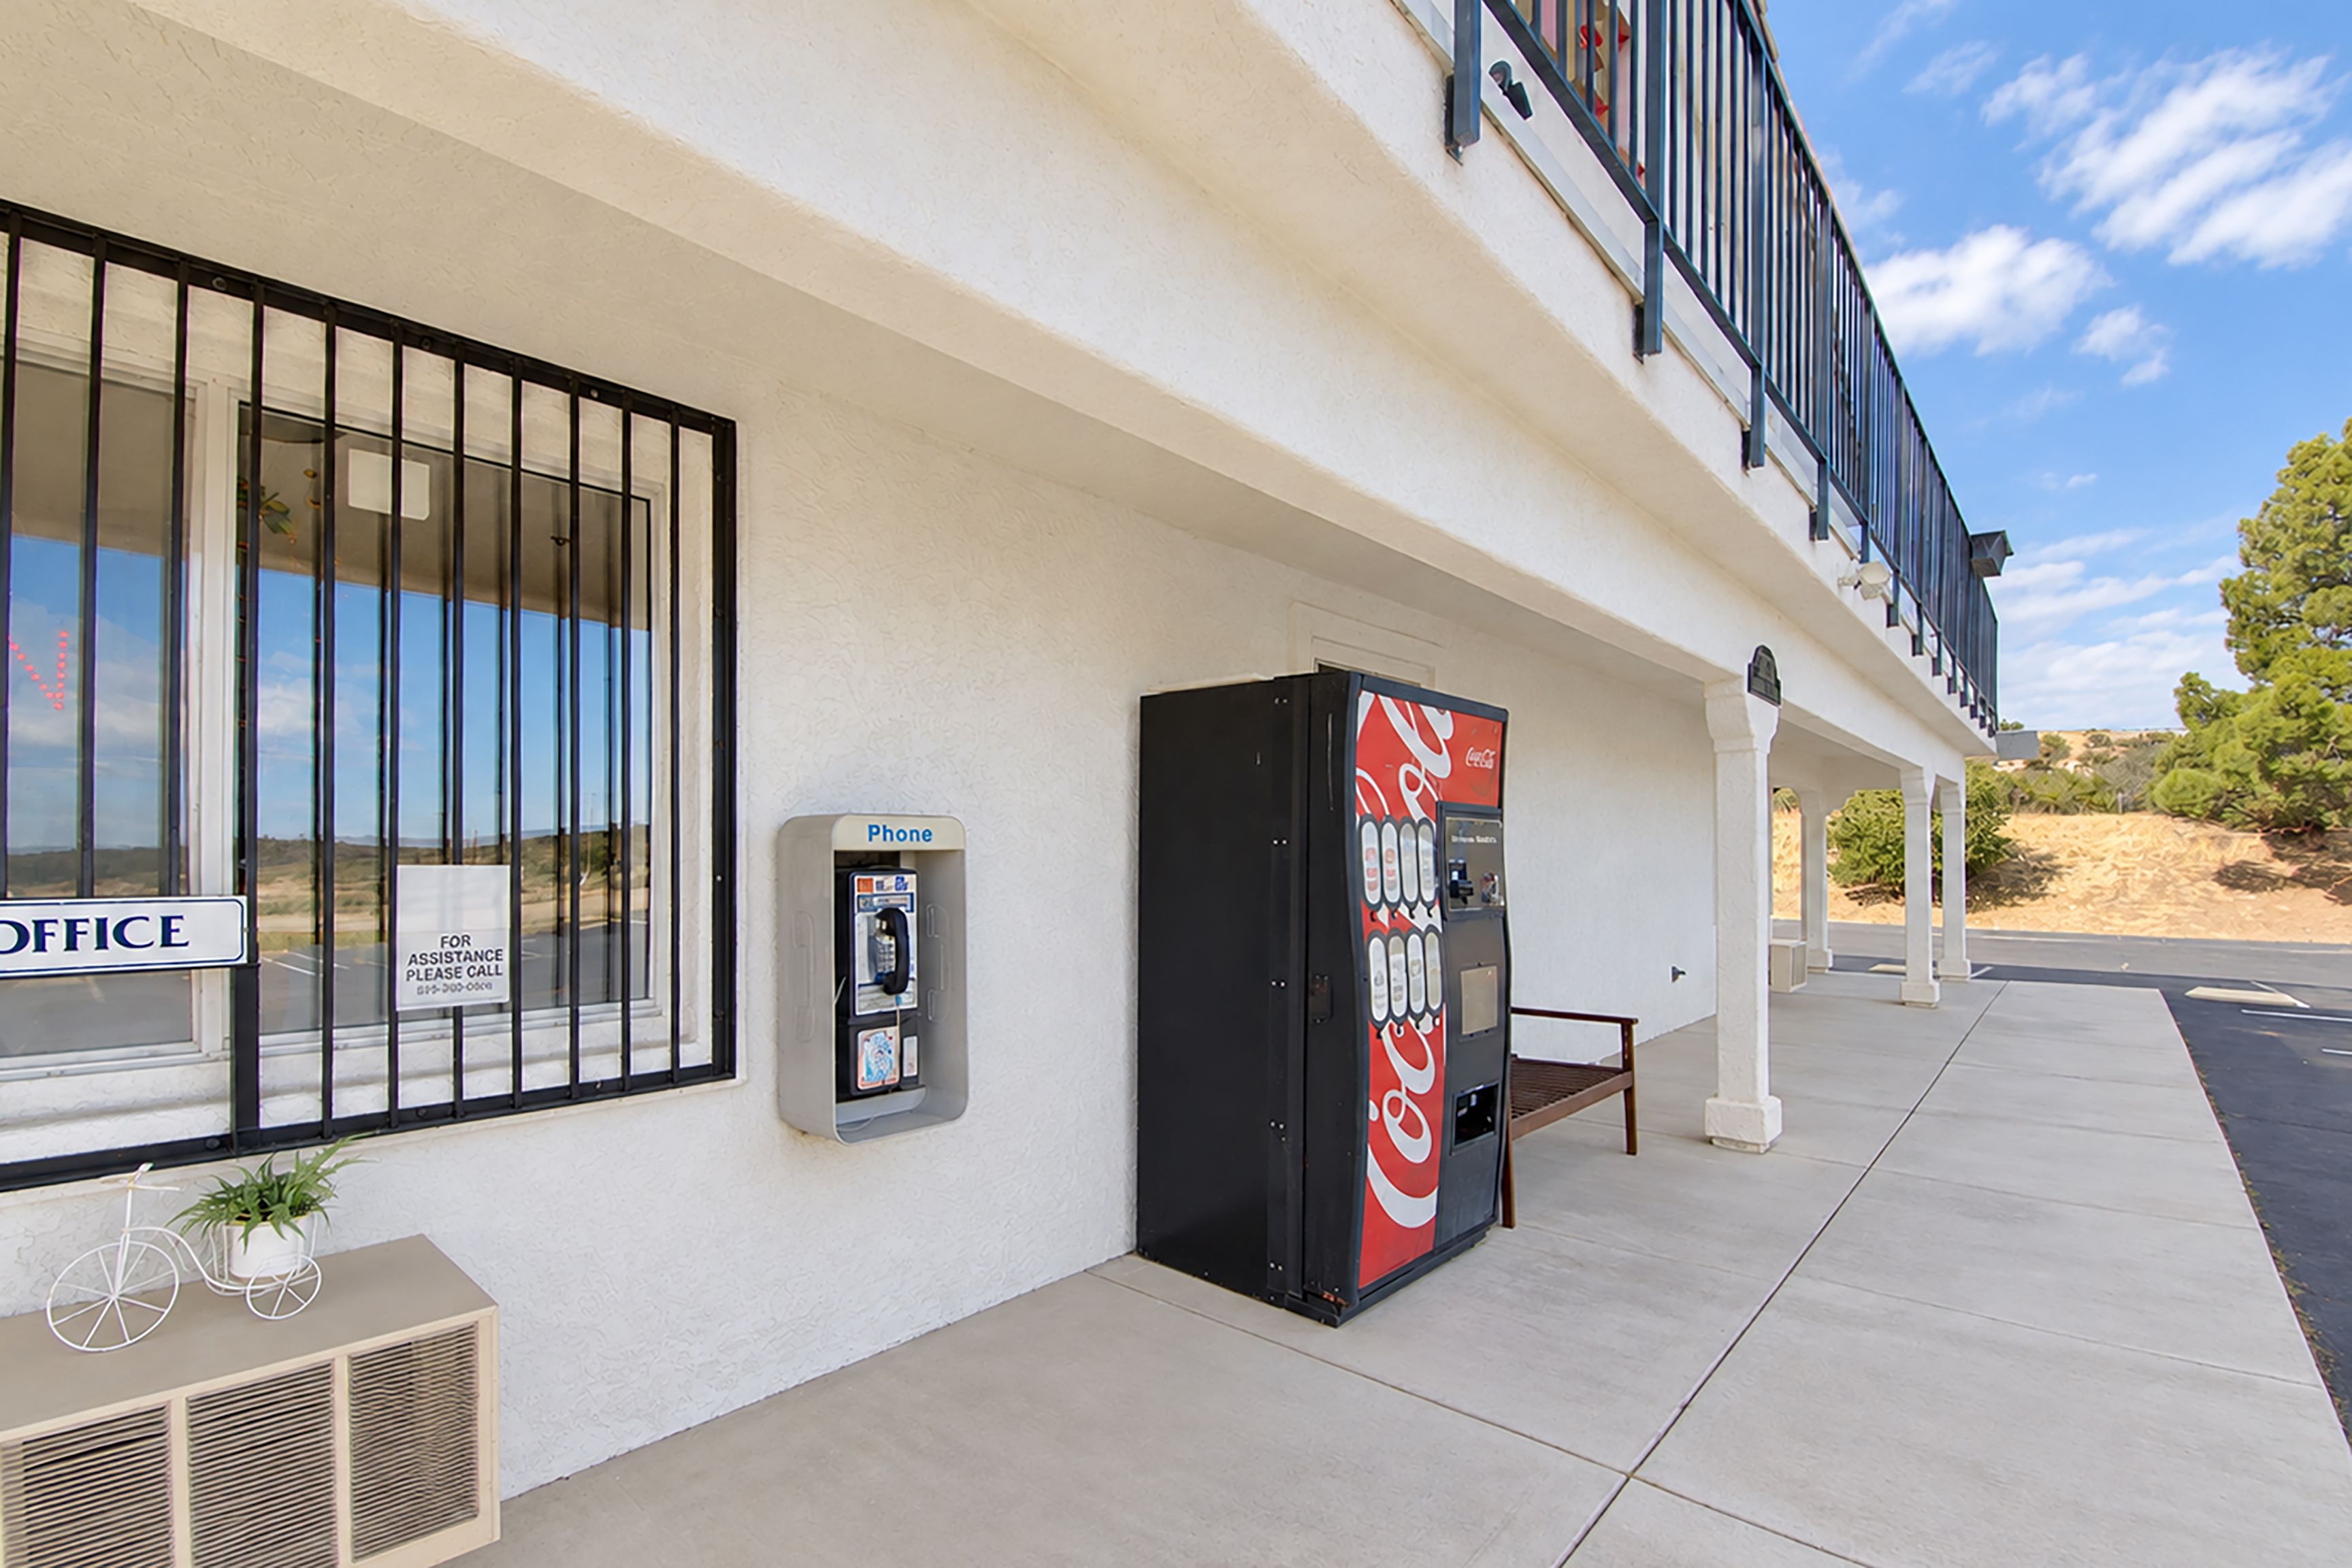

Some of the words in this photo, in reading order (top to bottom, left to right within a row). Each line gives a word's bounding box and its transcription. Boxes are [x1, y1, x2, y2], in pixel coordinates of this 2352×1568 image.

[868, 824, 933, 843] Phone
[440, 934, 471, 949] FOR
[408, 949, 503, 966] ASSISTANCE
[406, 966, 462, 981] PLEASE
[467, 964, 502, 978] CALL
